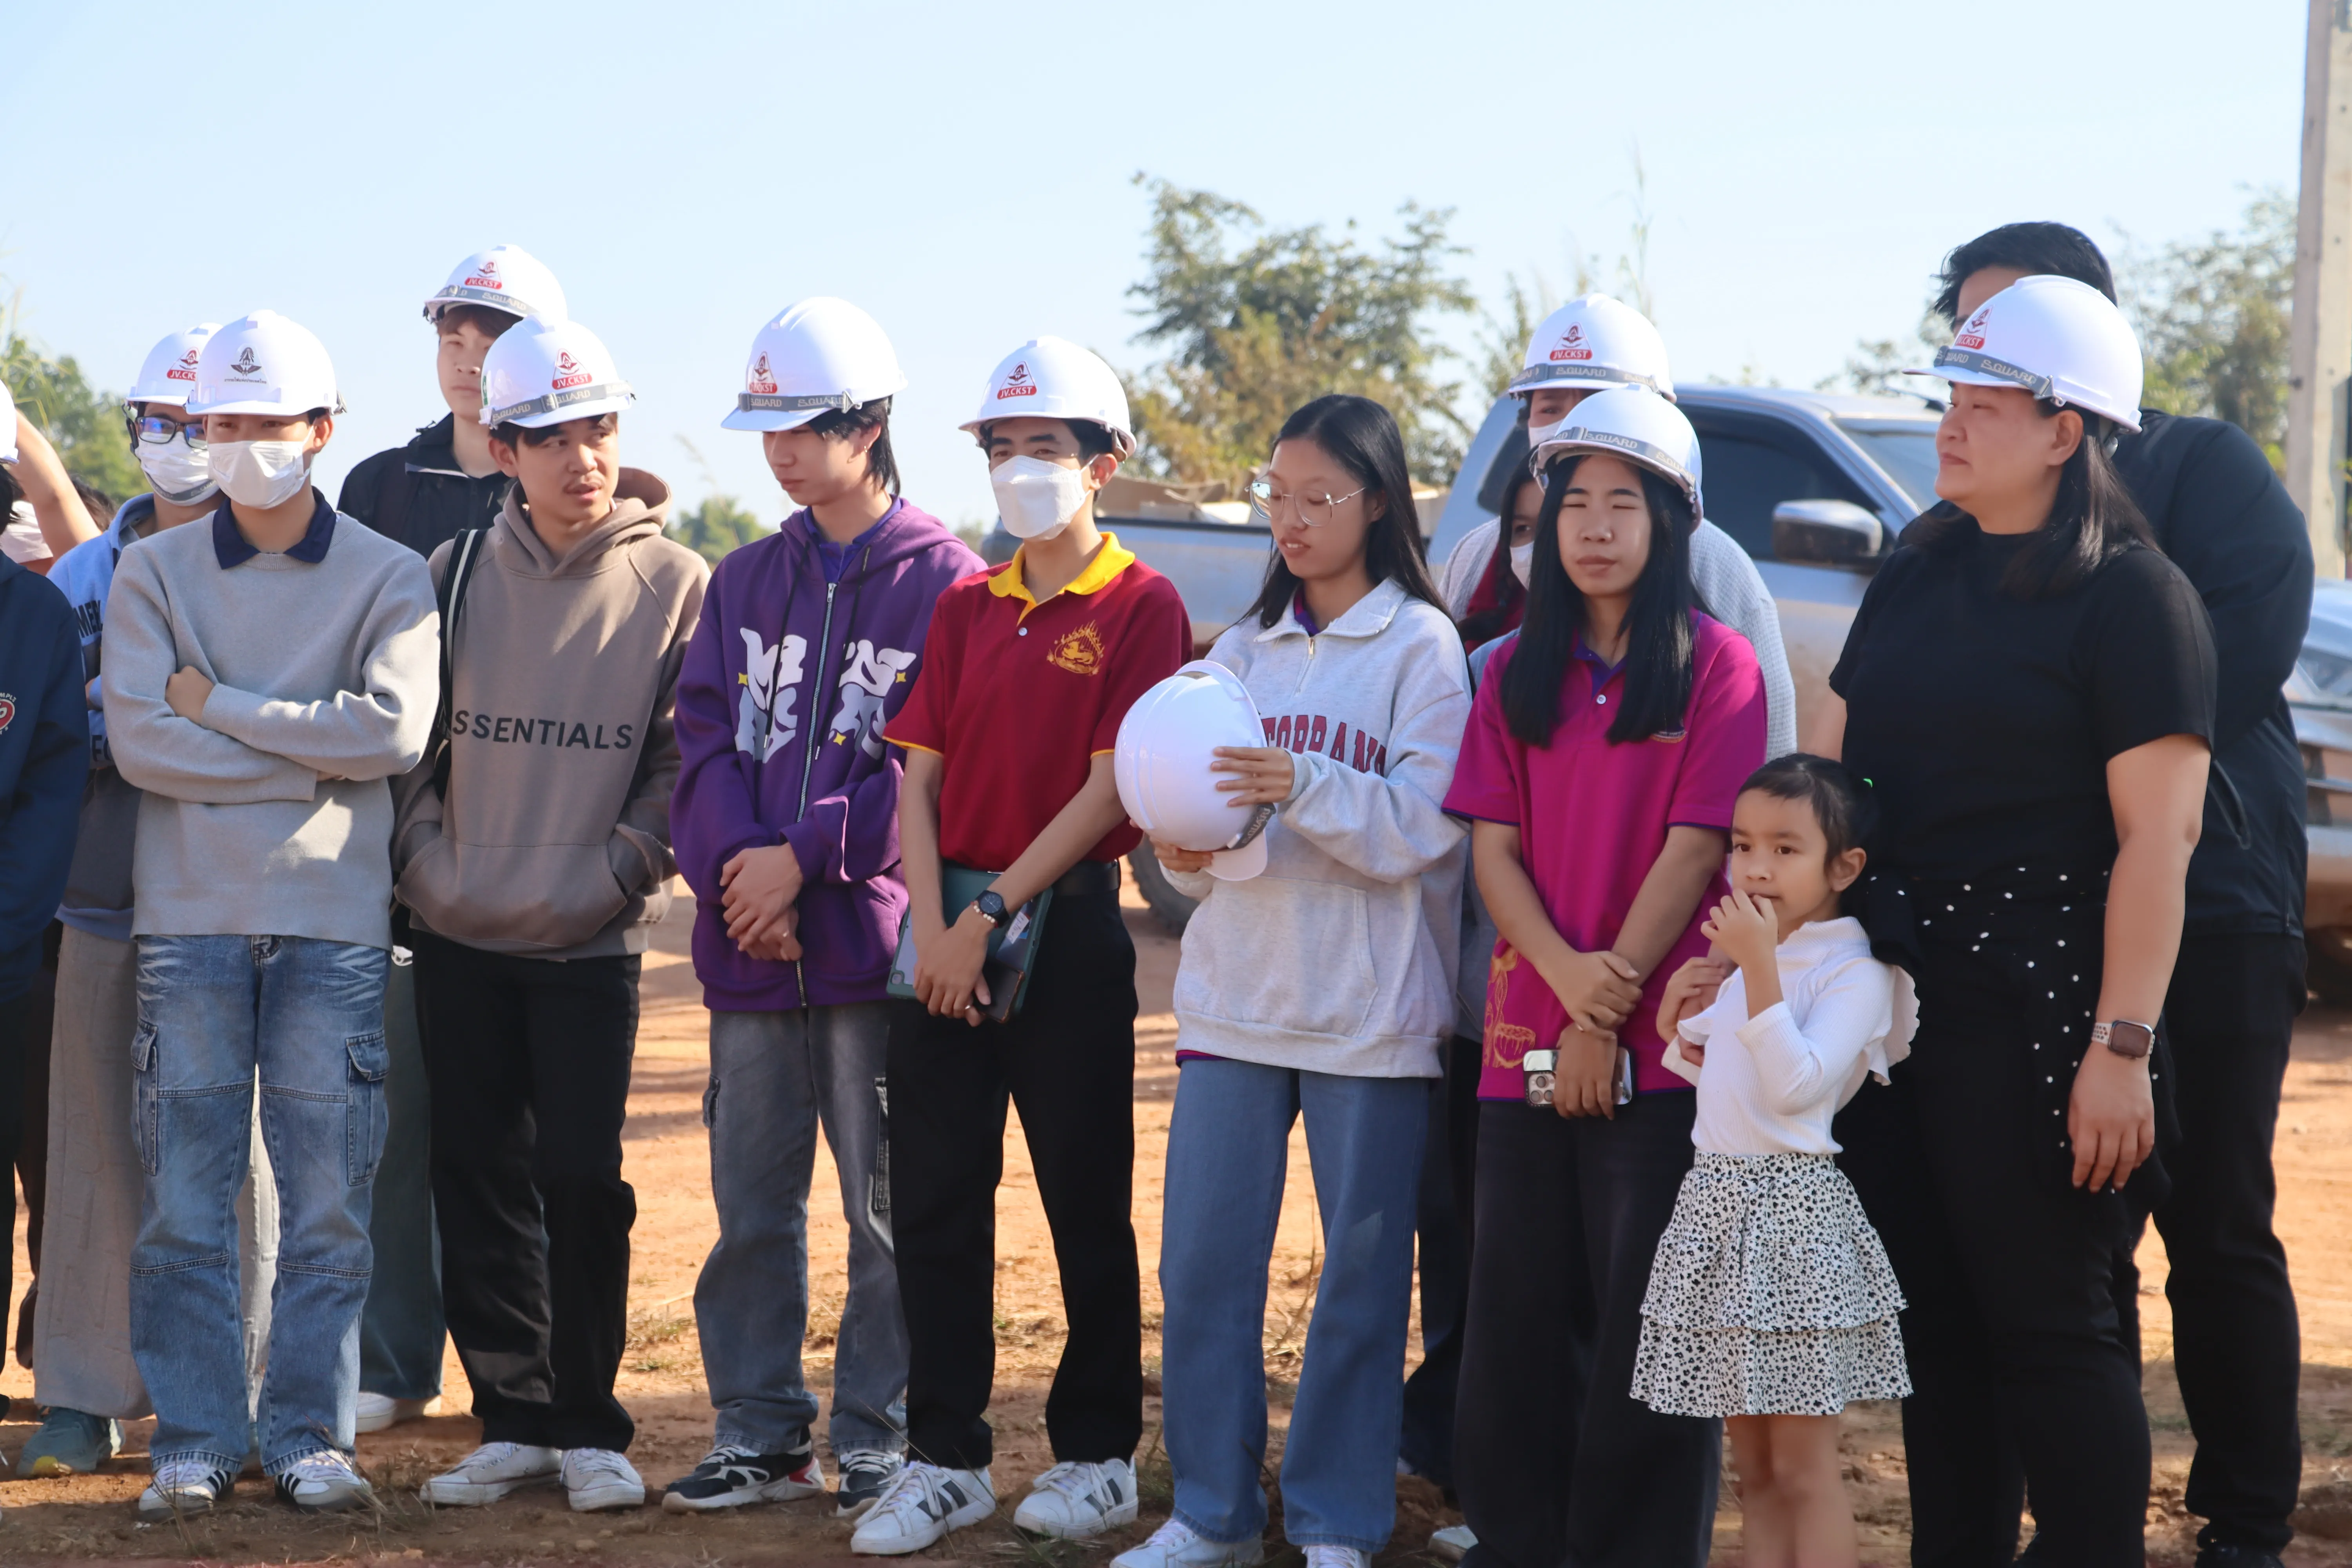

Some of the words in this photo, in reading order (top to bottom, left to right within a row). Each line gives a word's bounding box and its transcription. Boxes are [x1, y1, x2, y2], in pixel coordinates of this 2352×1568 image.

[467, 278, 499, 288] JV.CKST
[1553, 350, 1588, 359] JV.CKST
[557, 375, 588, 388] JV.CKST
[1000, 387, 1033, 398] JV.CKST
